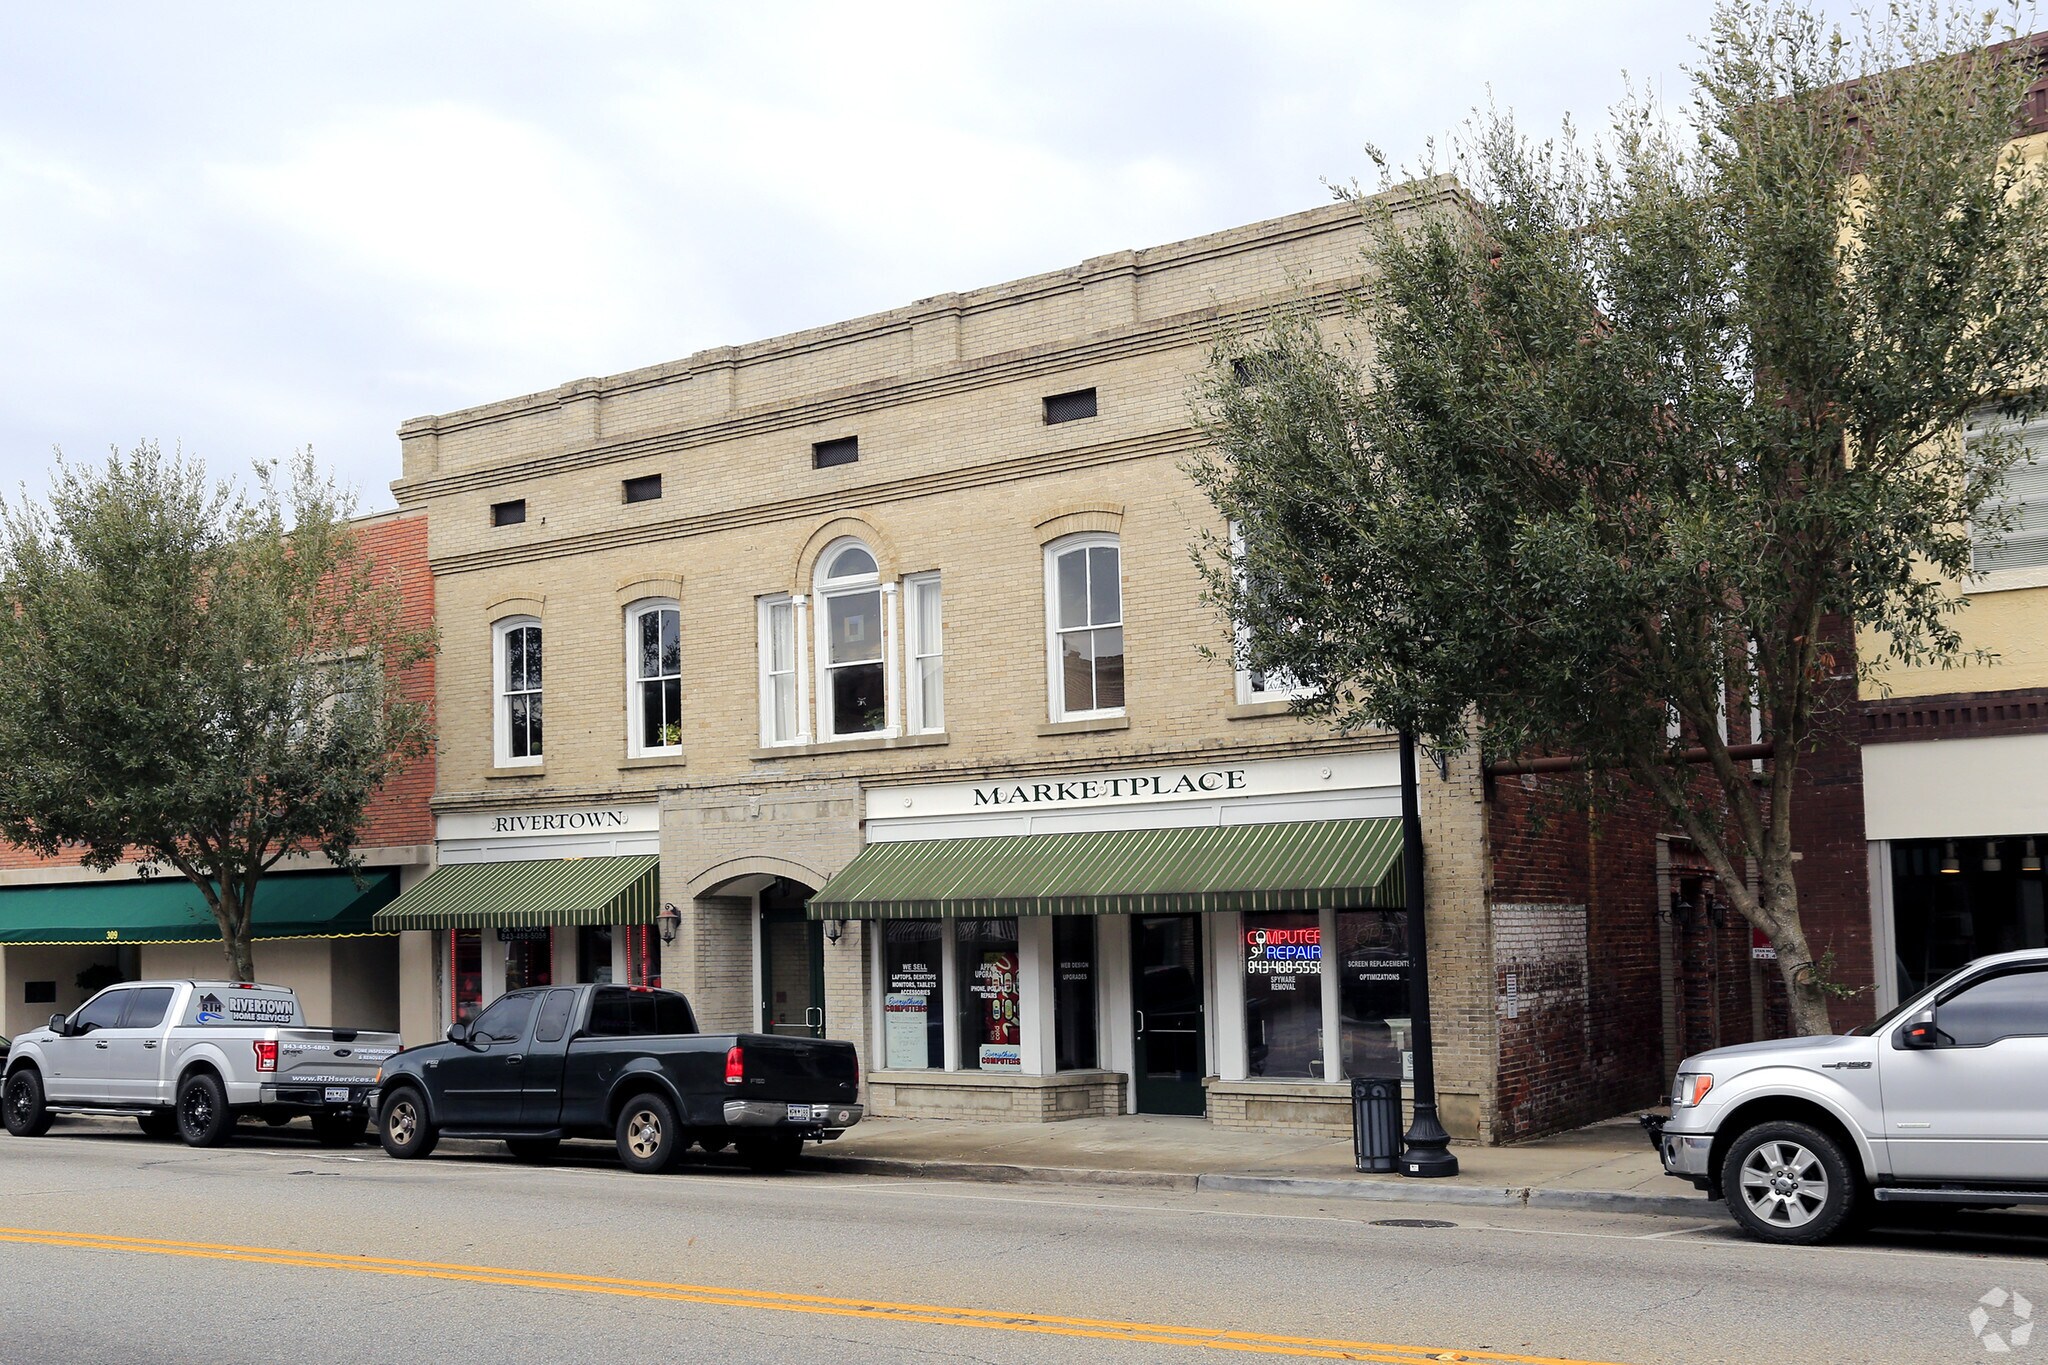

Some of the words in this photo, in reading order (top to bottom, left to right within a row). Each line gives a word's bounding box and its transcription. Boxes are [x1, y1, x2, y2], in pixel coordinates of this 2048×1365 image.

[973, 769, 1247, 806] MARKETPLACE
[496, 811, 623, 832] RIVERTOWN
[106, 930, 118, 940] 309
[1266, 945, 1322, 960] REPAIR
[902, 963, 912, 971] WE
[912, 963, 928, 971] SELL
[1347, 960, 1369, 968] SCREEN
[891, 973, 913, 981] LAPTOPS,
[1270, 975, 1296, 983] SPYWARE
[1359, 973, 1400, 981] OPTIMIZATIONS
[1270, 983, 1296, 991] REMOVAL
[201, 1003, 222, 1013] RTH
[228, 997, 294, 1015] RIVERTOWN
[233, 1011, 256, 1021] HOME
[255, 1012, 291, 1024] SERVICES
[981, 1057, 1021, 1065] COMPUTERS
[291, 1074, 378, 1084] www.RTHservices.n
